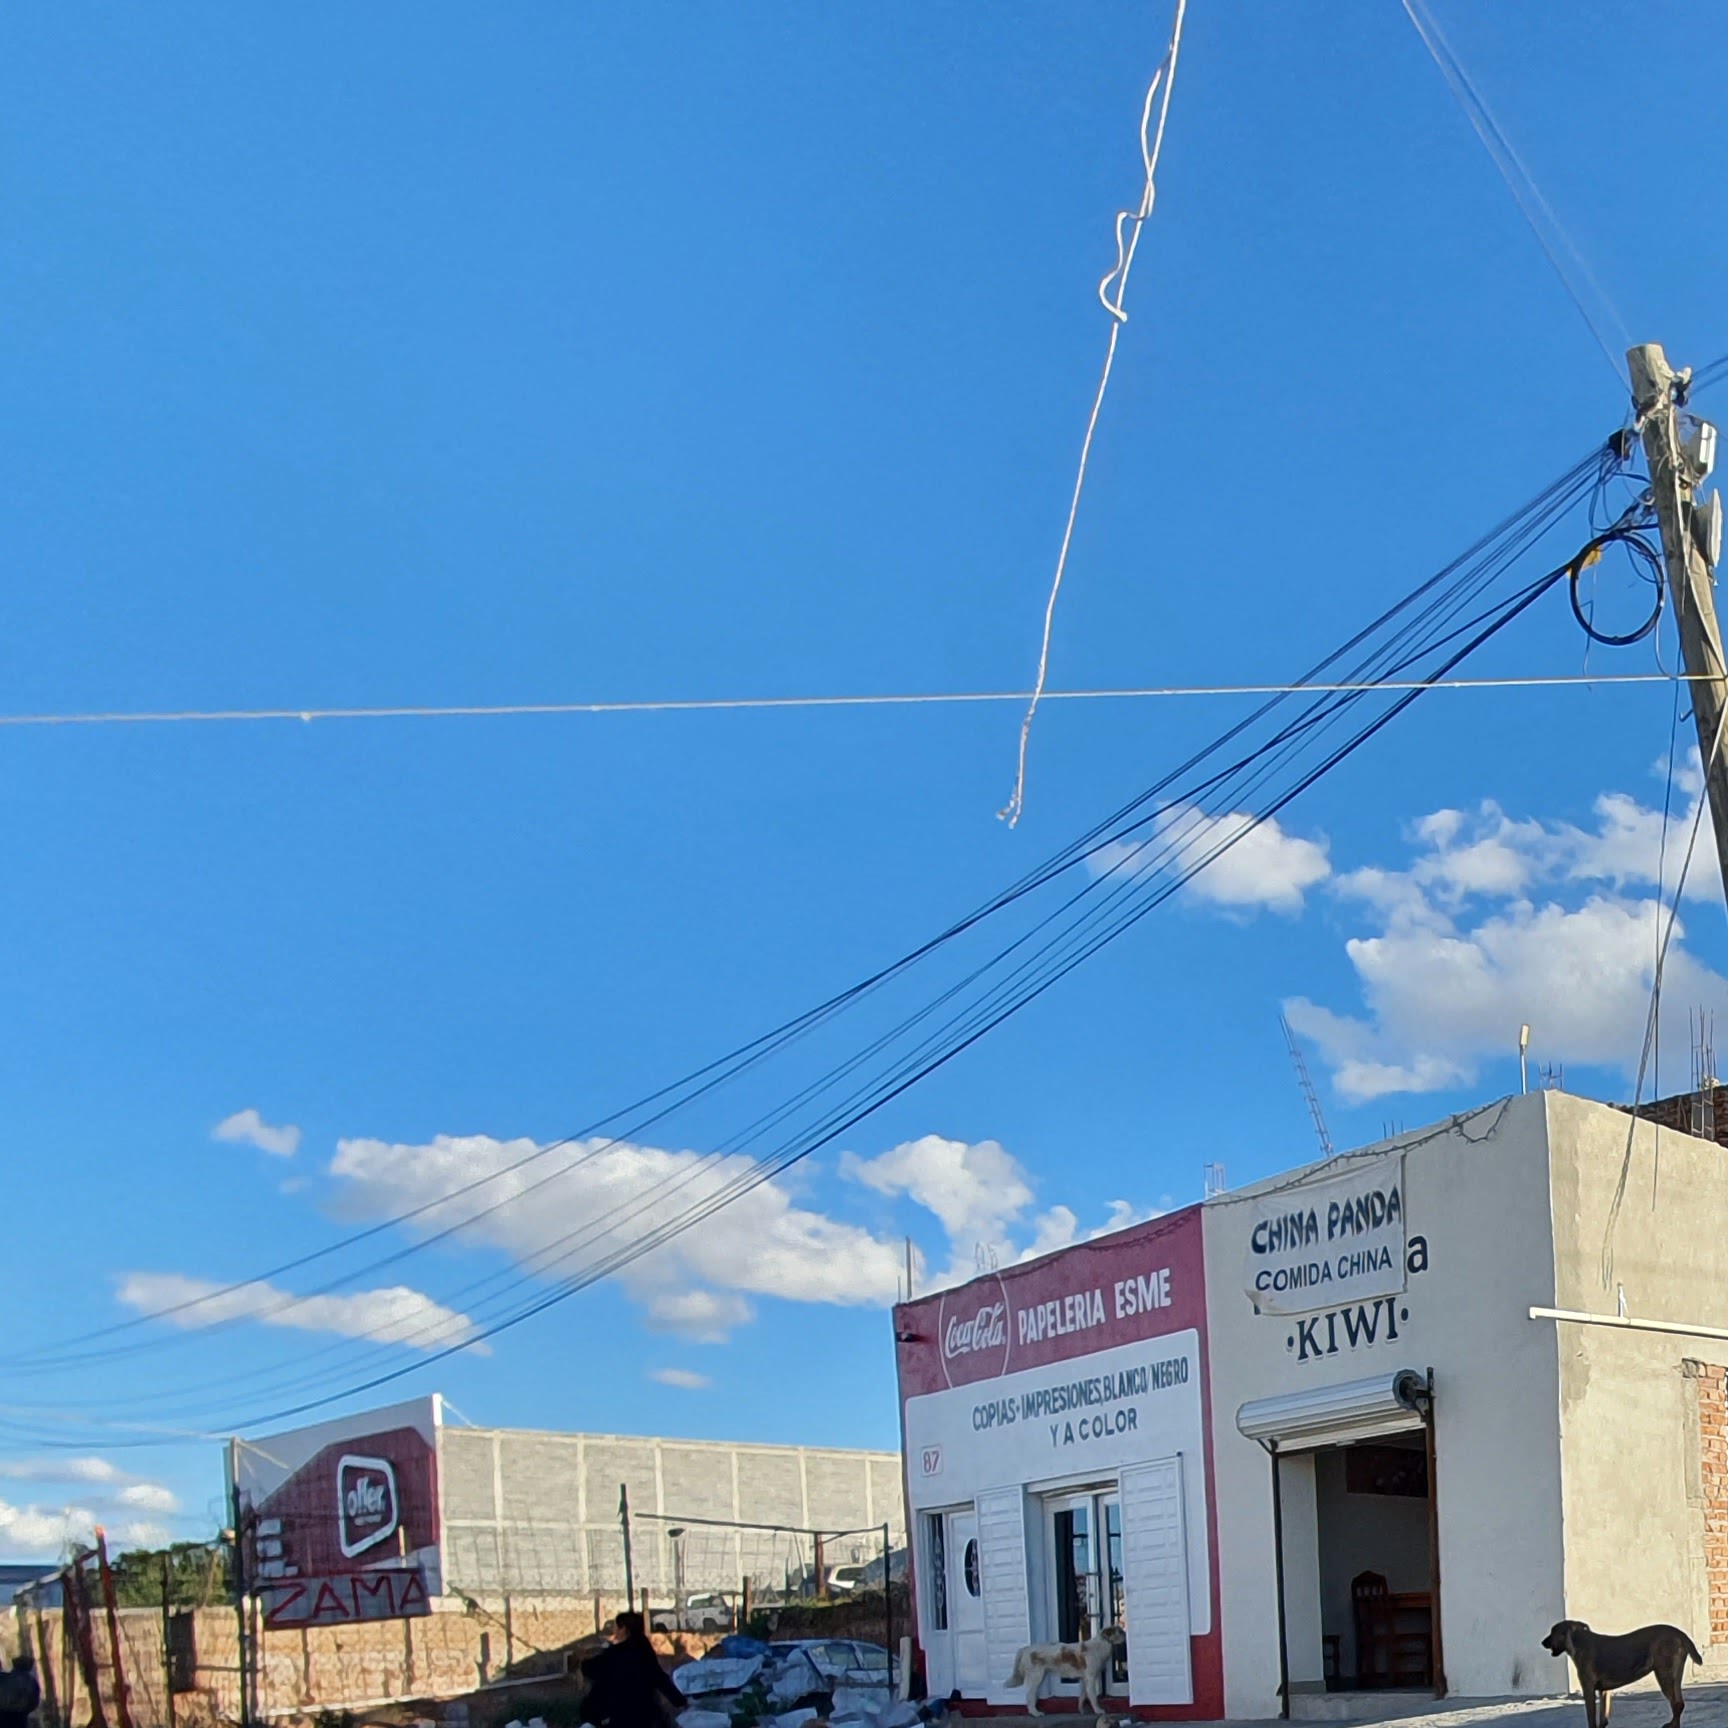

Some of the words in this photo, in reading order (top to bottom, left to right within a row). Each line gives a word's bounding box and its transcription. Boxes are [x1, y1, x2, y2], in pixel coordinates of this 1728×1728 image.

[1251, 1207, 1319, 1254] CHINA
[1327, 1184, 1402, 1241] PANDA
[1255, 1261, 1333, 1292] COMIDA
[1337, 1245, 1393, 1280] CHINA
[1017, 1288, 1106, 1346] PAPELERIA
[1114, 1267, 1172, 1320] ESME
[1049, 1423, 1060, 1448] Y
[1062, 1420, 1075, 1446] A
[1078, 1407, 1138, 1441] COLOR
[922, 1450, 940, 1474] 87
[263, 1573, 427, 1626] ZAMA
